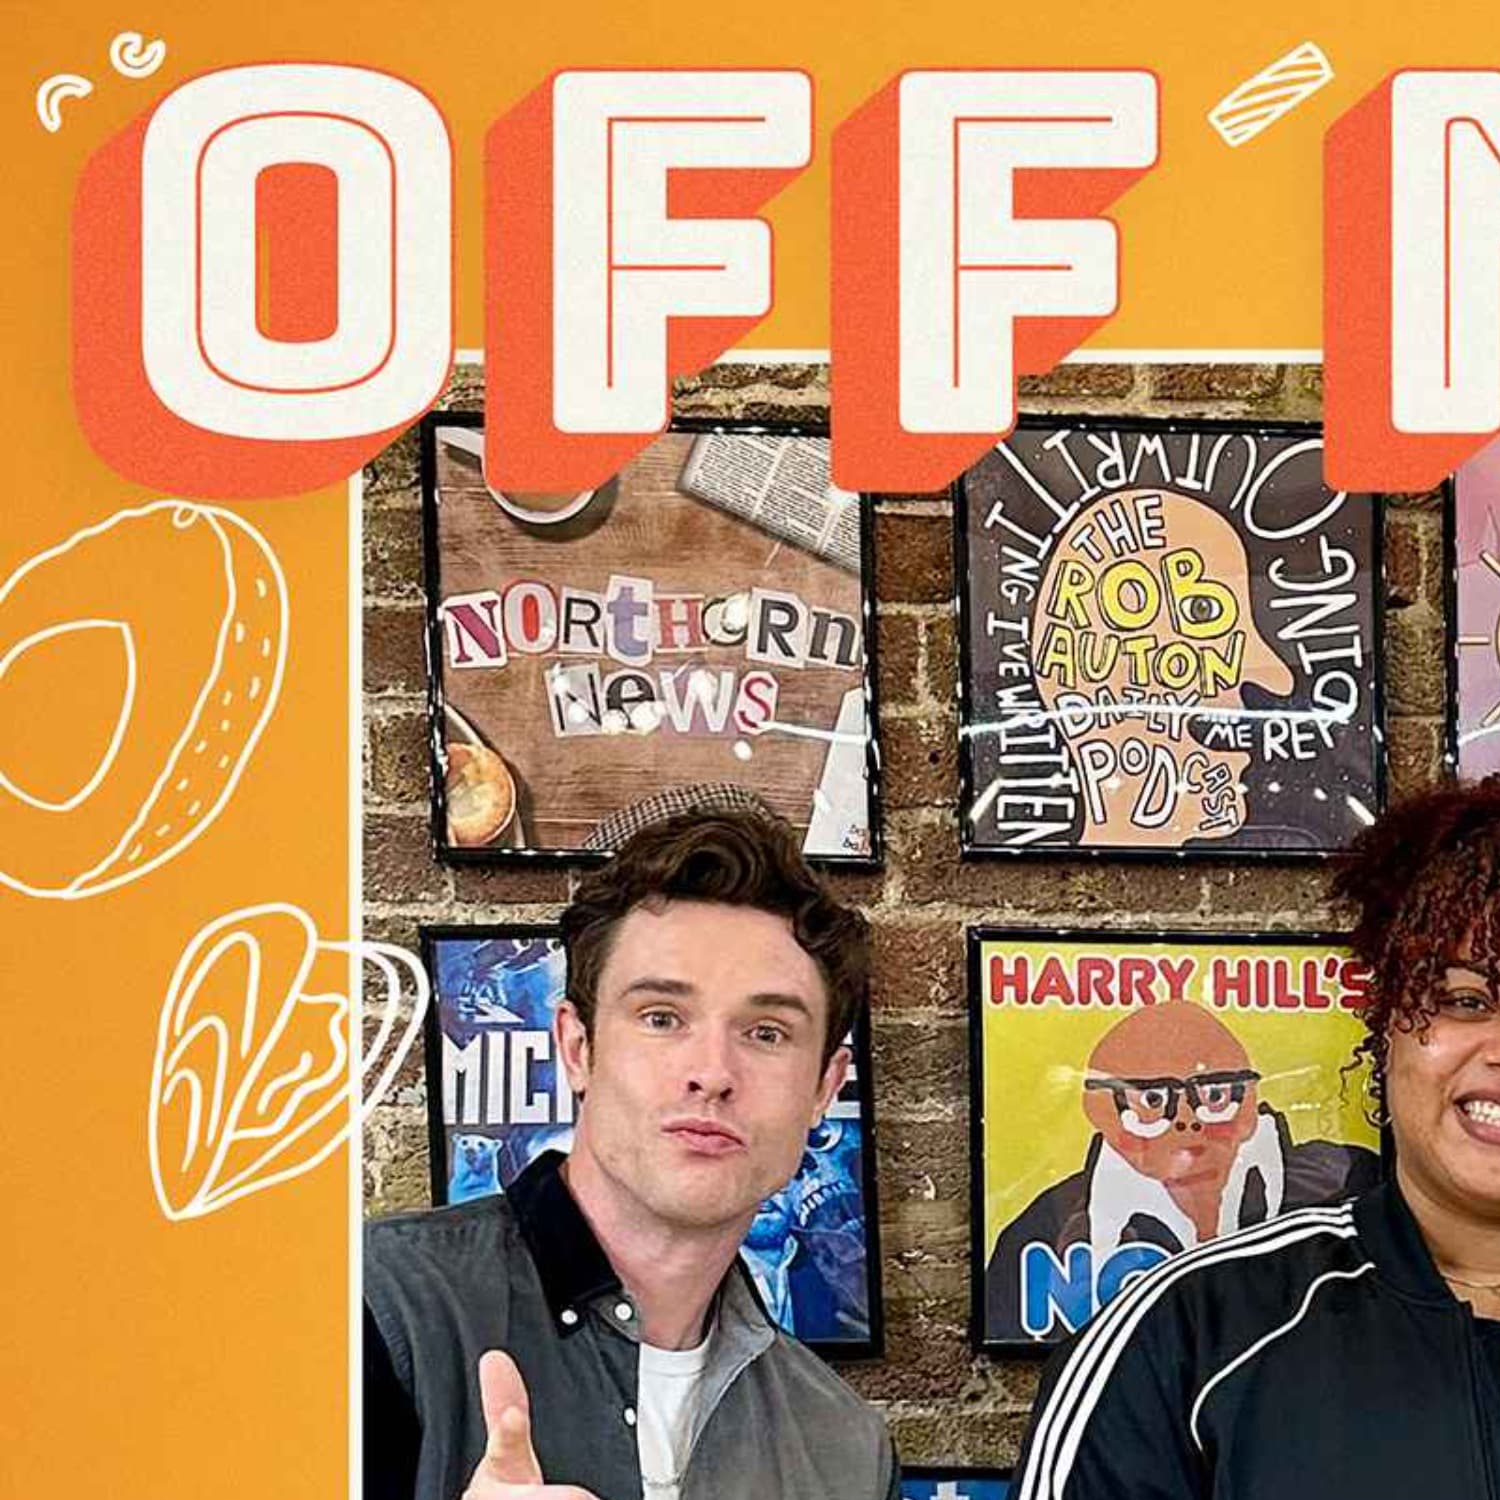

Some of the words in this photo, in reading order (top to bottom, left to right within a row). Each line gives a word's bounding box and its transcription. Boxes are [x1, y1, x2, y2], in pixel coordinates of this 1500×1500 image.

[1069, 494, 1167, 564] THE
[1046, 547, 1240, 641] ROB
[1038, 622, 1246, 698] AUTON
[1055, 684, 1201, 742] DAILY
[1078, 736, 1241, 831] PODCAST
[988, 954, 1196, 1006] HARRY
[1212, 956, 1371, 1010] HILL'S
